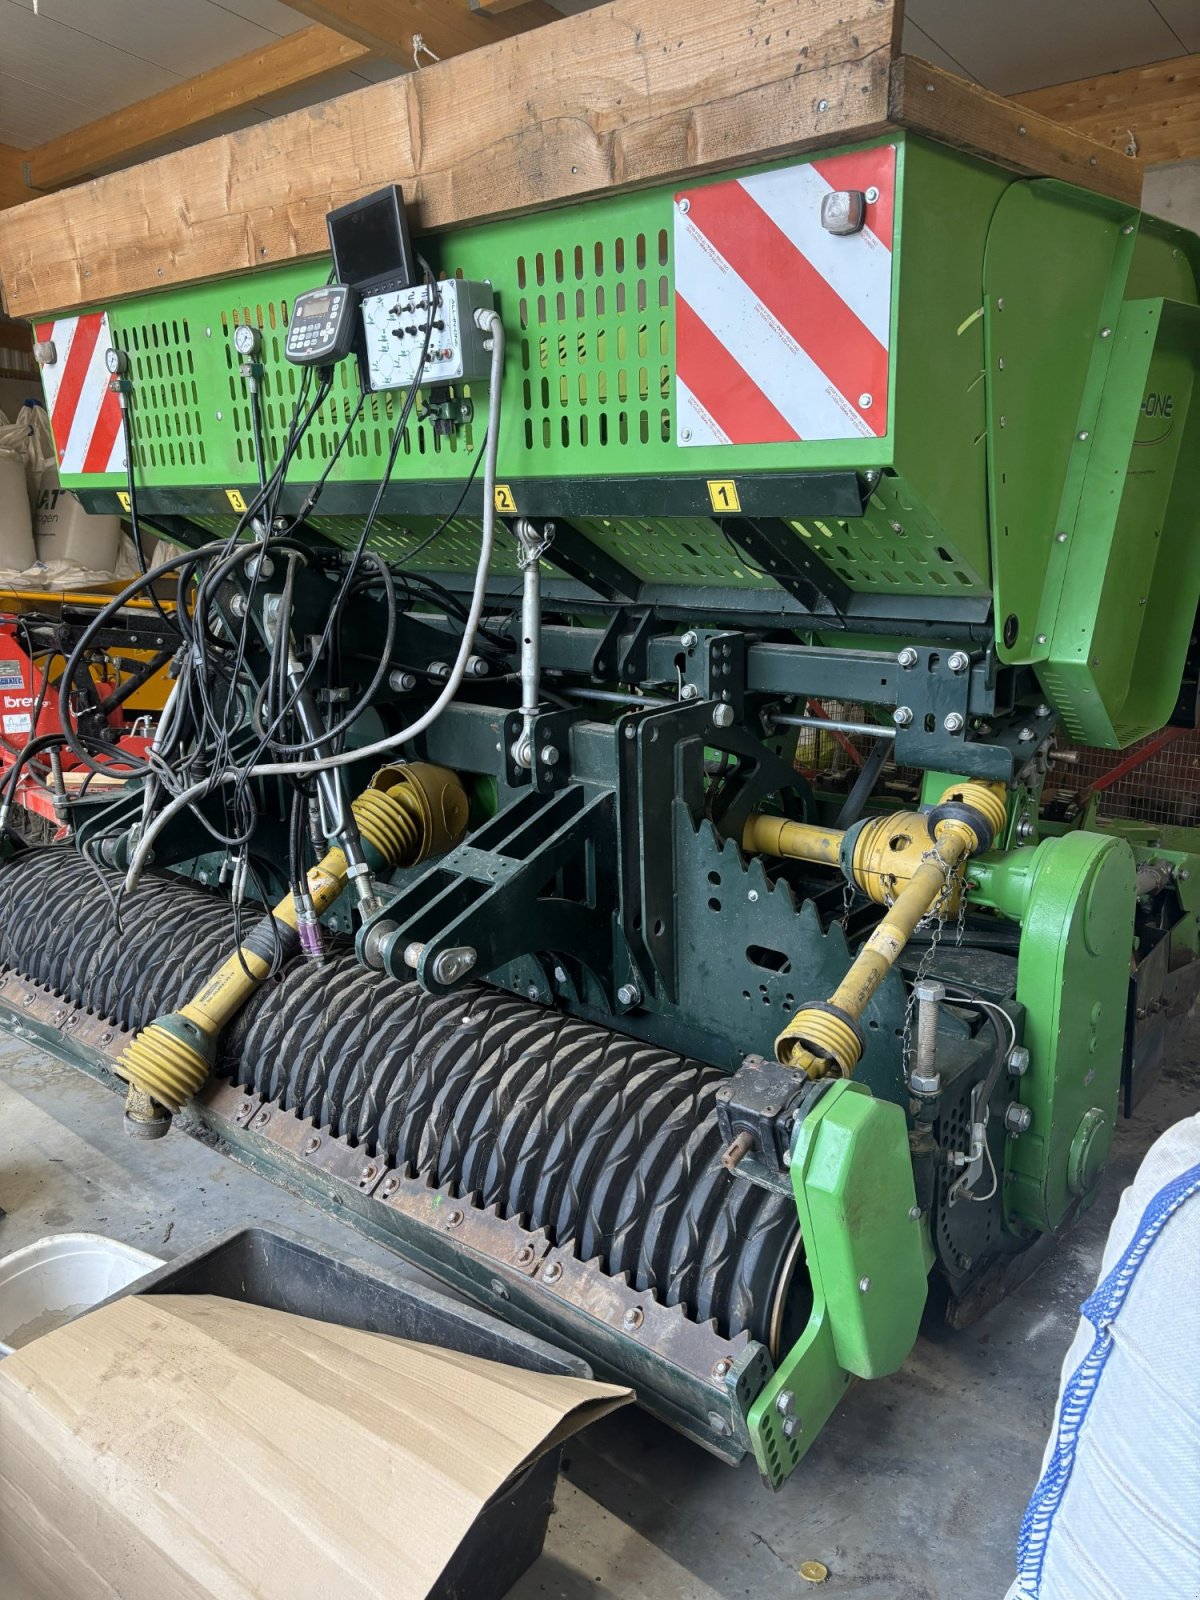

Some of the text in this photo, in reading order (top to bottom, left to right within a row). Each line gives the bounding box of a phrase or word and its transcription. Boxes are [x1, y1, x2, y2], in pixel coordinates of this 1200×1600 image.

[232, 494, 242, 508] 3
[497, 490, 511, 508] 2
[718, 486, 729, 506] 1
